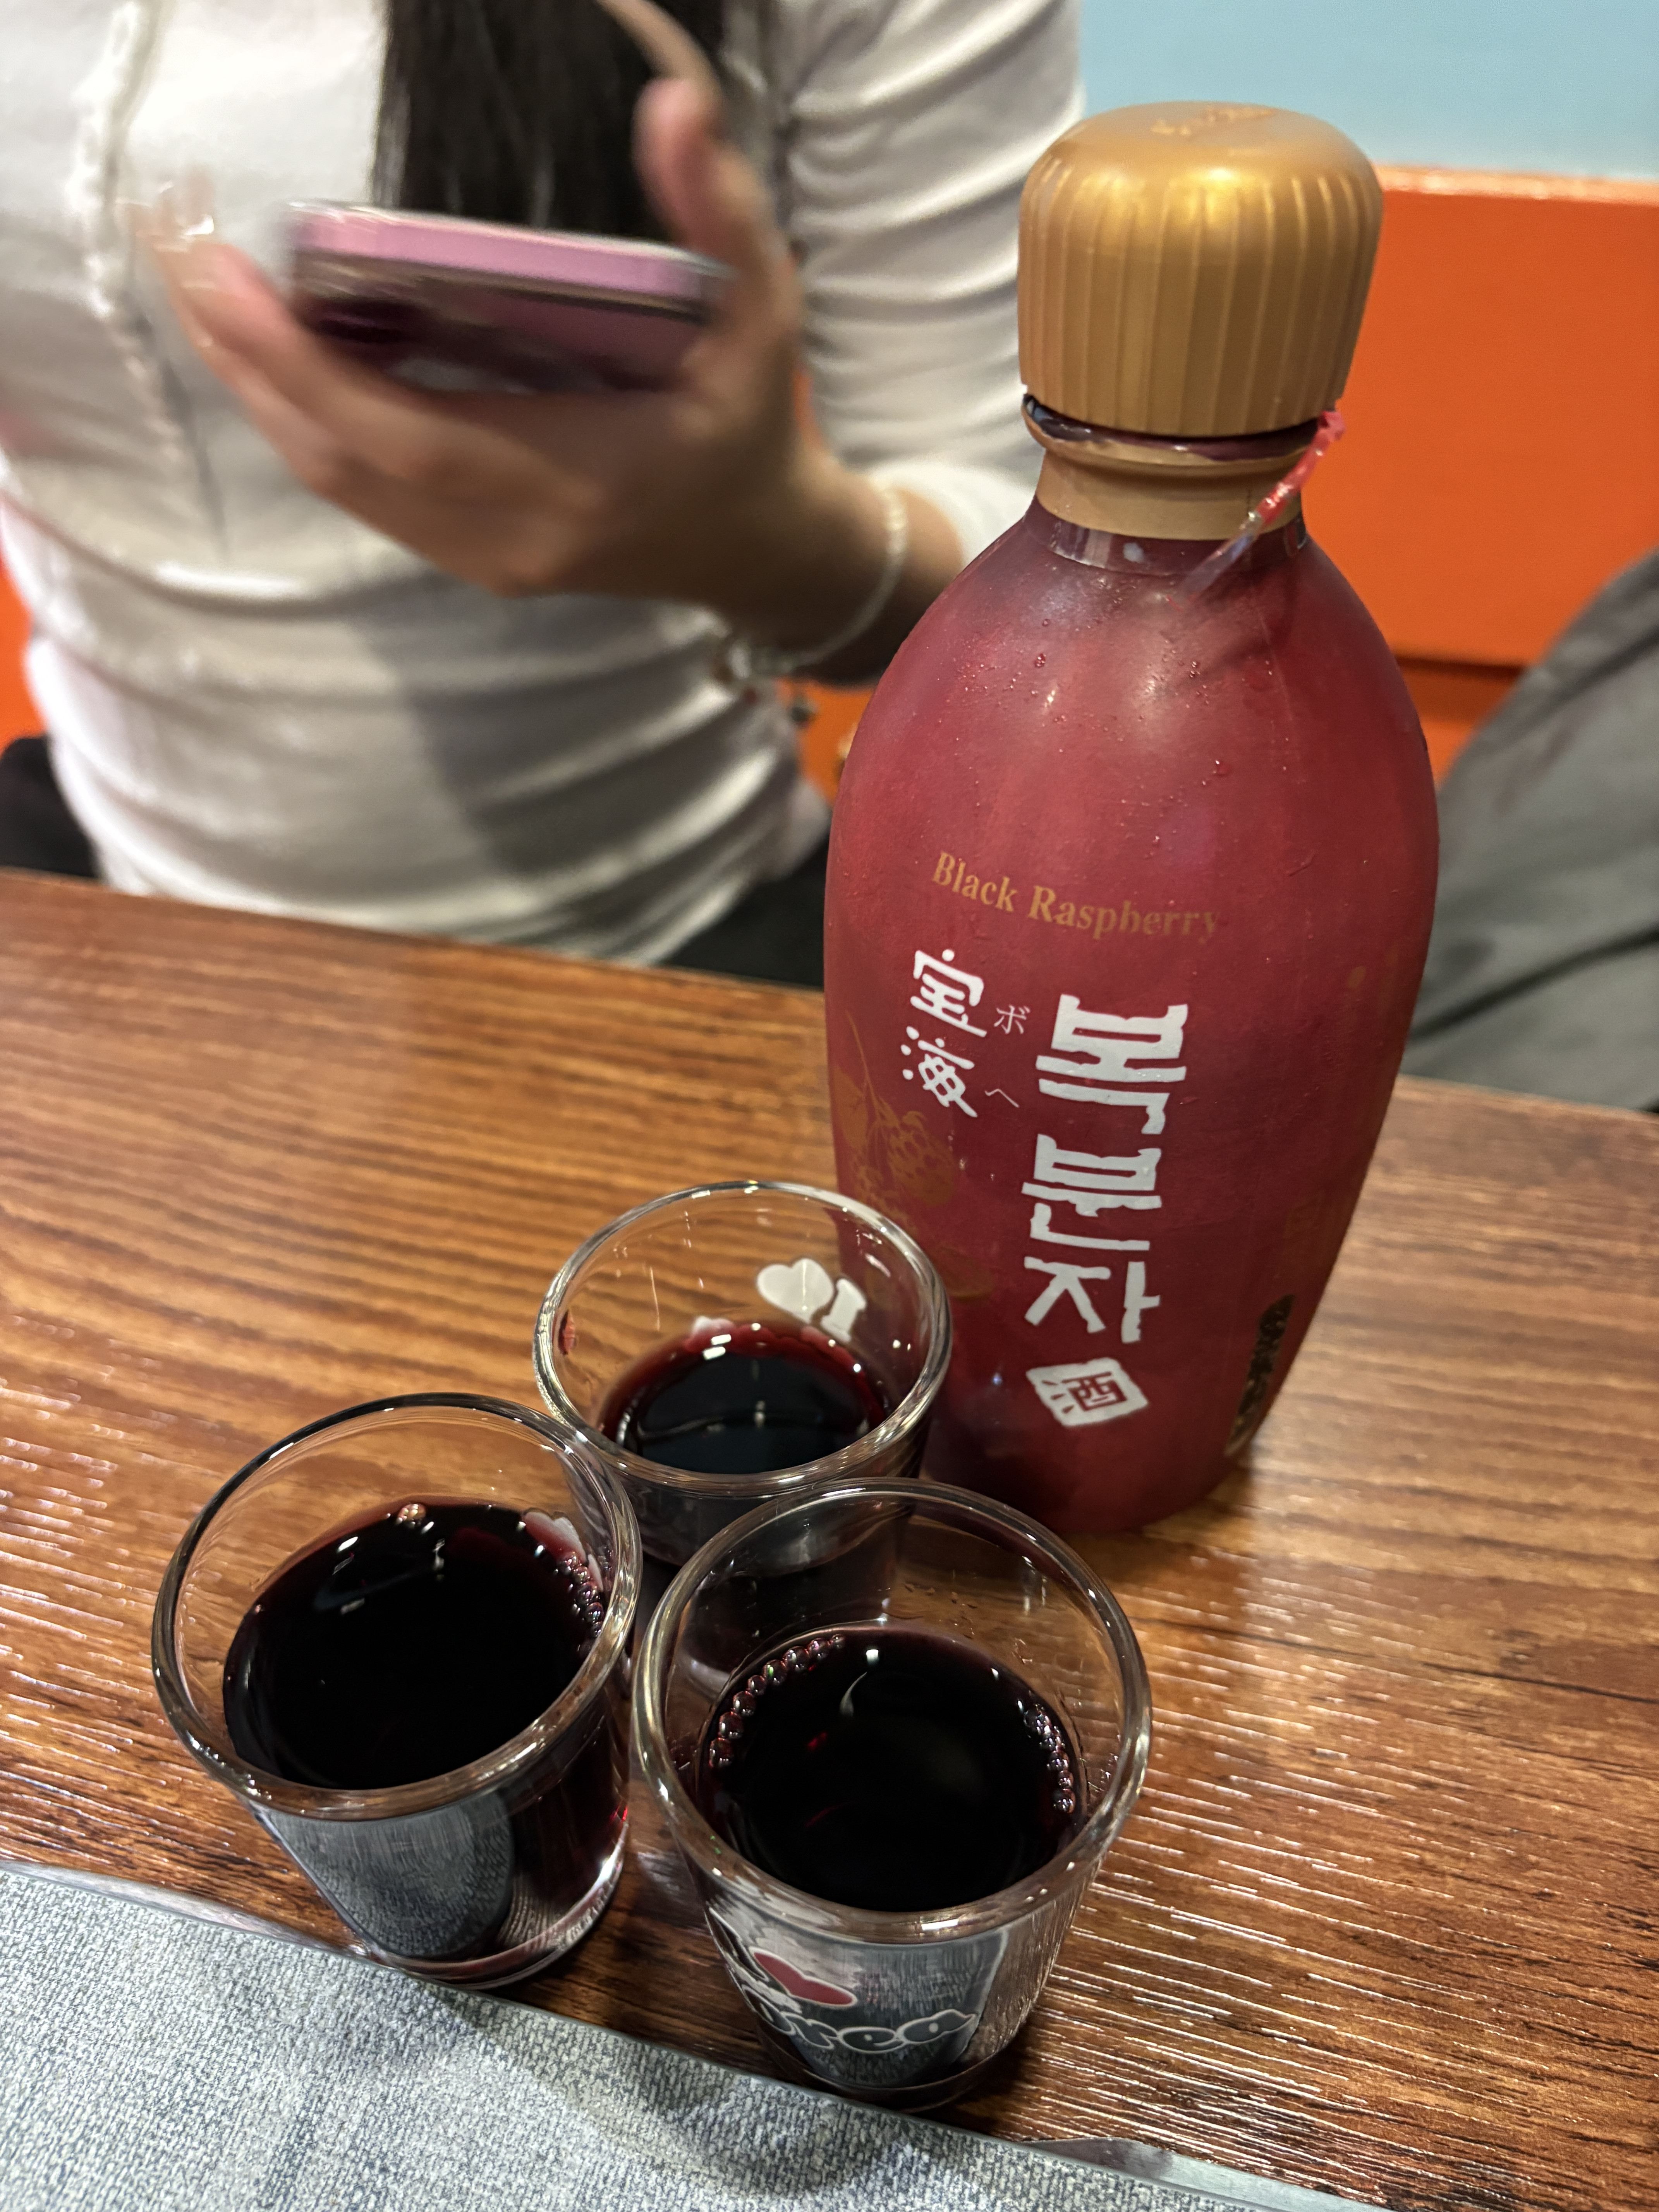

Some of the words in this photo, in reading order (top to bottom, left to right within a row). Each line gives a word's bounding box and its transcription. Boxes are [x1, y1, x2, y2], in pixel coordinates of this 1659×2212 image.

[931, 850, 1018, 912] Black
[1028, 885, 1222, 944] Raspberry
[1022, 994, 1188, 1343] 복분자
